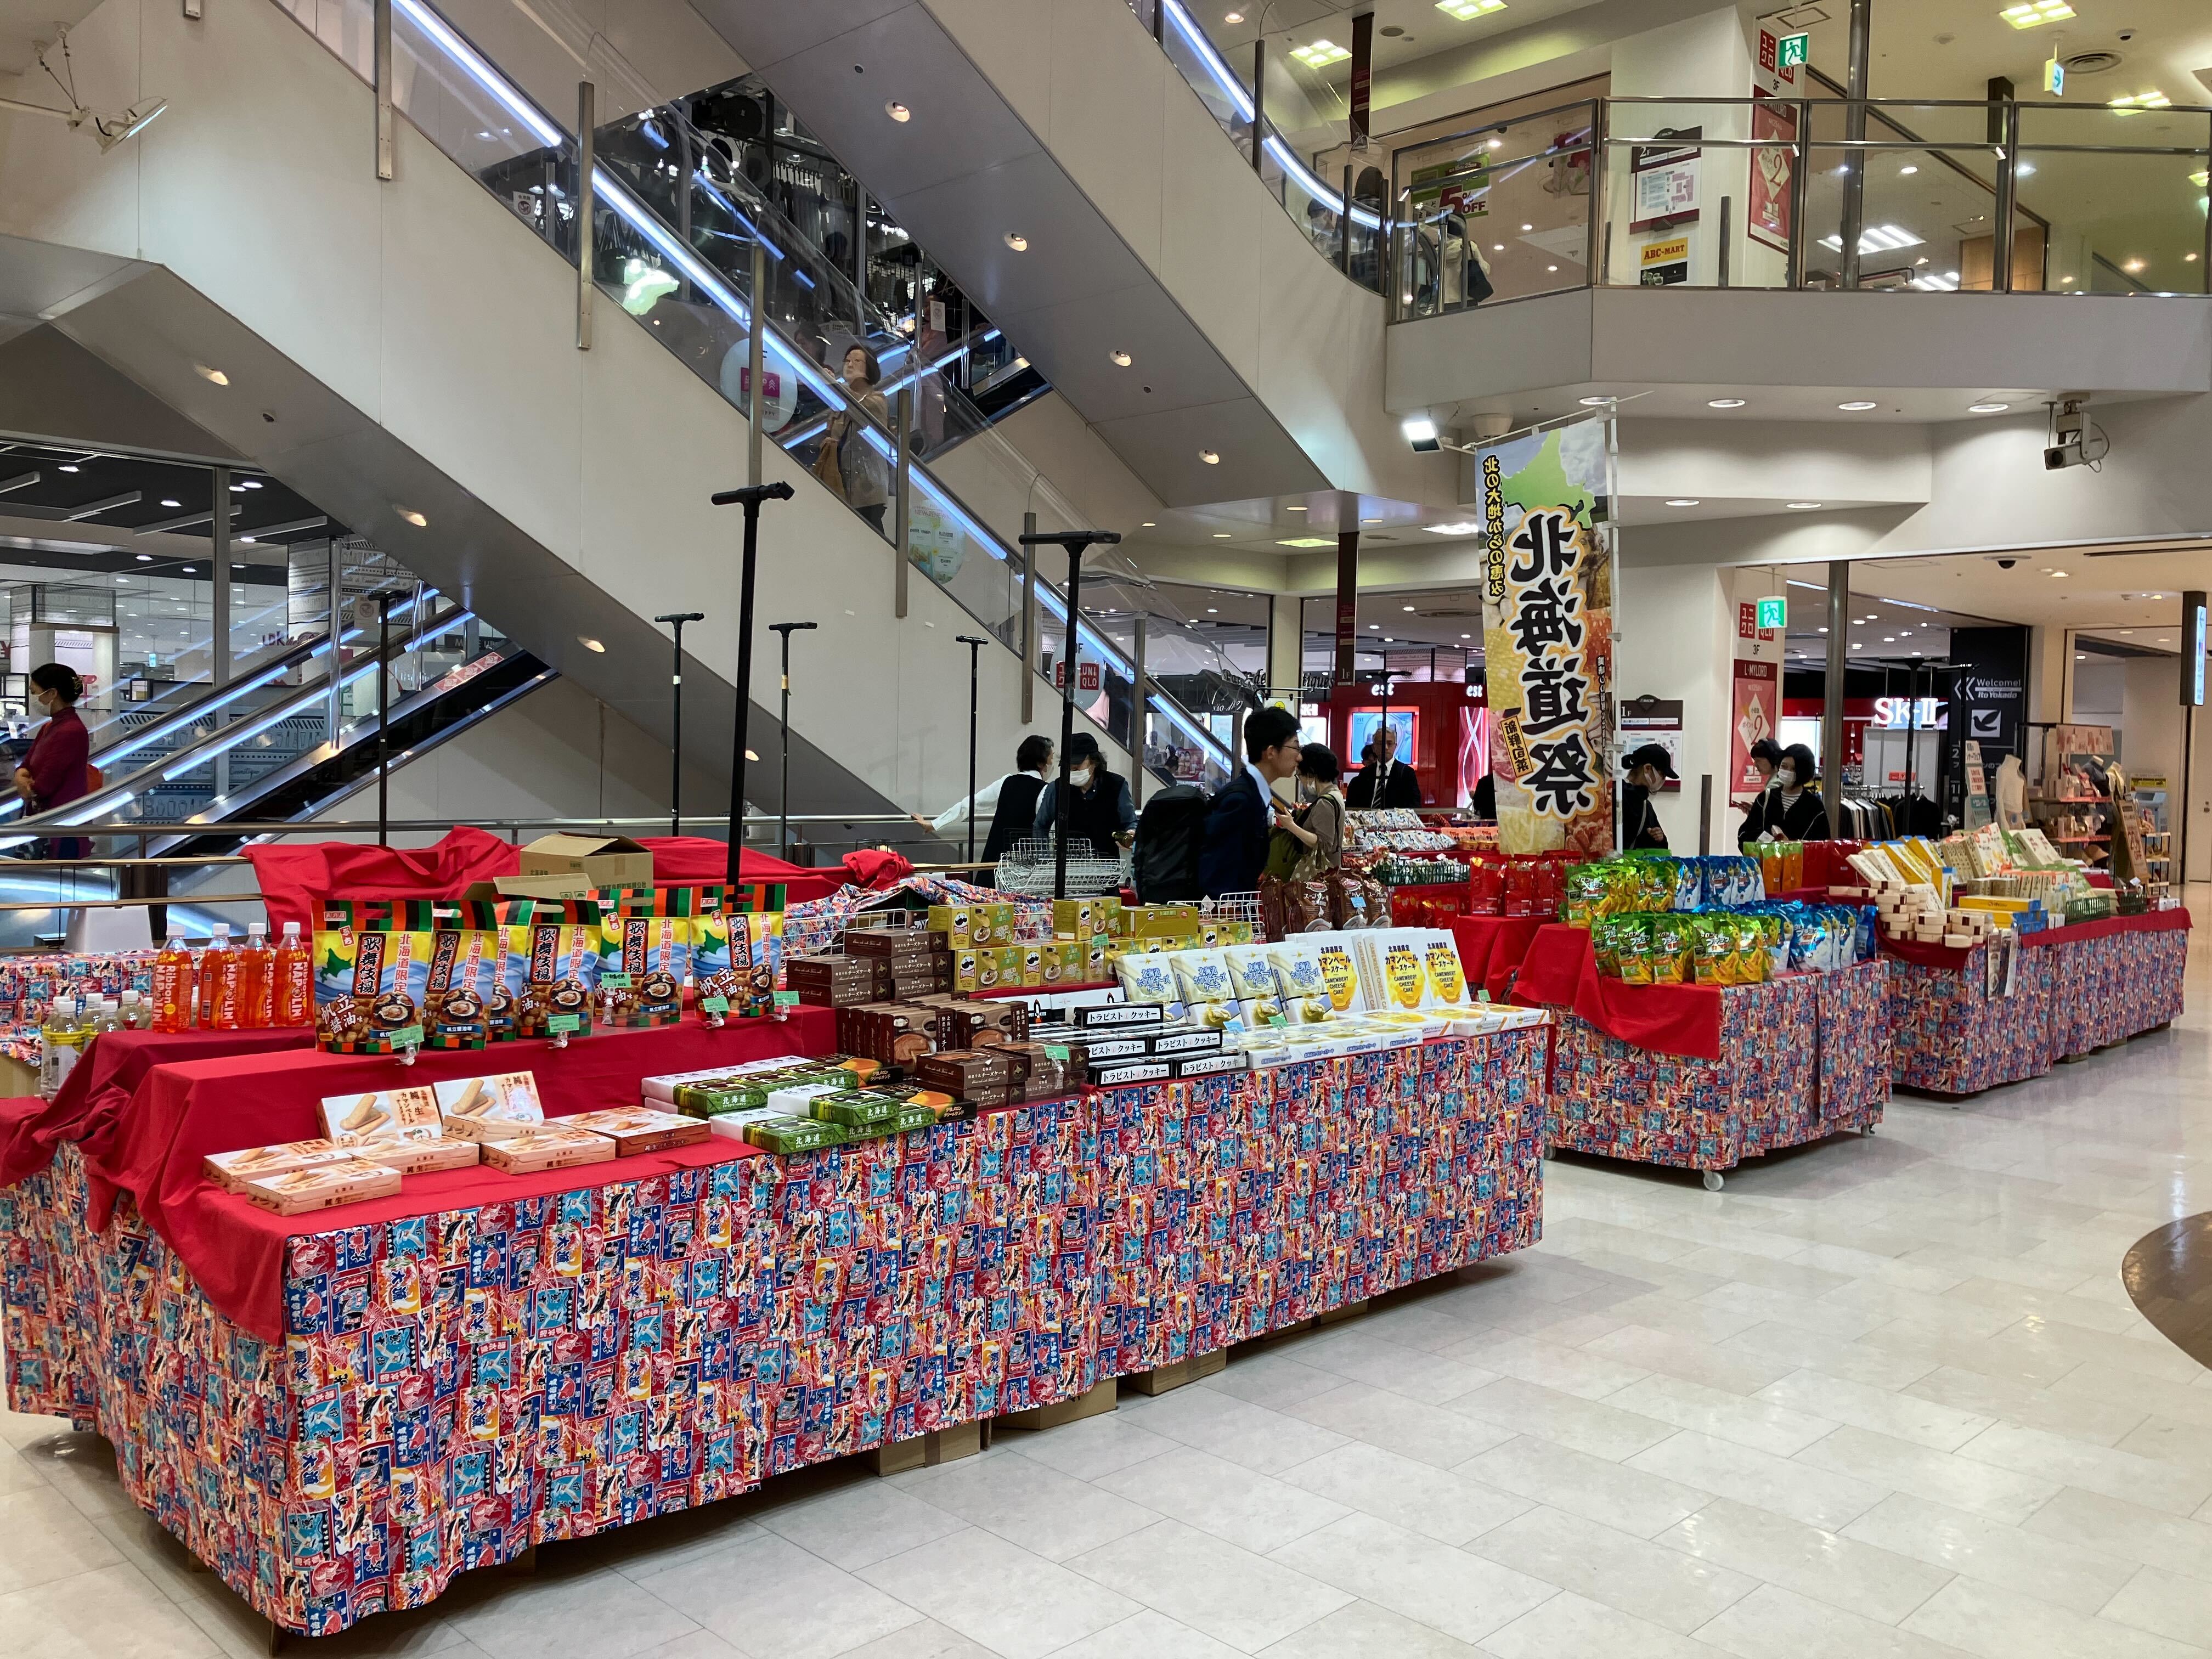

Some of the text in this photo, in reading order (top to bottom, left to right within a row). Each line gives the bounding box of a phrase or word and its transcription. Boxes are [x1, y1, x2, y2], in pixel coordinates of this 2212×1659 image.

[1773, 78, 1780, 91] 3F
[1639, 146, 1651, 157] 2F
[1770, 154, 1782, 187] 2
[1462, 201, 1486, 214] OFF
[1644, 244, 1685, 261] ABC-MART
[1753, 644, 1760, 656] 3F
[1082, 666, 1097, 676] UNI
[1082, 677, 1097, 688] QLO
[1302, 673, 1335, 692] tiques
[1977, 678, 2021, 687] Welcome!
[1466, 684, 1483, 697] est
[1621, 706, 1632, 716] 1F
[659, 918, 673, 972] 北海道限定
[731, 916, 749, 967] 歌舞伎揚
[759, 913, 771, 966] 北海道限定
[533, 928, 556, 981] 歌舞伎揚
[568, 926, 586, 981] 北海道限定
[626, 921, 645, 974] 歌舞伎揚
[430, 933, 456, 990] 歌舞伎揚
[462, 933, 483, 990] 北海道限定
[1357, 941, 1369, 977] CAMEMBERT
[1385, 953, 1418, 964] カマンベール
[1425, 950, 1456, 962] カマンベール
[356, 936, 382, 994] 歌舞伎揚
[394, 933, 413, 994] 北海道限定
[1322, 965, 1348, 974] チーズケーキ
[1390, 963, 1416, 972] チーズケーキ
[1430, 960, 1454, 968] チーズケーキ
[1193, 971, 1228, 985] ホワイトチーズ
[1243, 967, 1273, 981] ホワイトチーズ
[1290, 967, 1320, 980] ホワイトチーズ
[1369, 943, 1385, 1001] CAMEMBERT CHEESE
[164, 965, 176, 1003] Ribbon
[698, 968, 735, 995] 帆立
[1136, 973, 1171, 987] ホワイトチーズ
[1204, 980, 1221, 991] ケーキ
[1252, 977, 1269, 987] ケーキ
[1300, 975, 1315, 986] ケーキ
[153, 964, 166, 1022] NAPOLIN
[223, 963, 237, 1020] NAPOLIN
[291, 962, 303, 1018] NAPOLIN
[1147, 983, 1164, 994] ケーキ
[320, 993, 356, 1024] 帆立
[1090, 1009, 1158, 1023] トラピスト クッキー
[330, 1013, 363, 1034] 醤油味
[1088, 1043, 1143, 1055] ピスト クッキー
[1158, 1036, 1218, 1050] トラピスト クッキー
[1183, 1062, 1214, 1074] トラピスト
[1103, 1068, 1166, 1084] トラピスト クッキー
[410, 1091, 424, 1116] 純生
[723, 1094, 747, 1104] 北海道
[400, 1092, 415, 1125] カマンベール
[867, 1105, 888, 1115] 北海道
[900, 1114, 922, 1125] 北海道
[848, 1125, 872, 1135] 北海道
[795, 1133, 821, 1144] 北海道
[391, 1270, 408, 1301] 大漁
